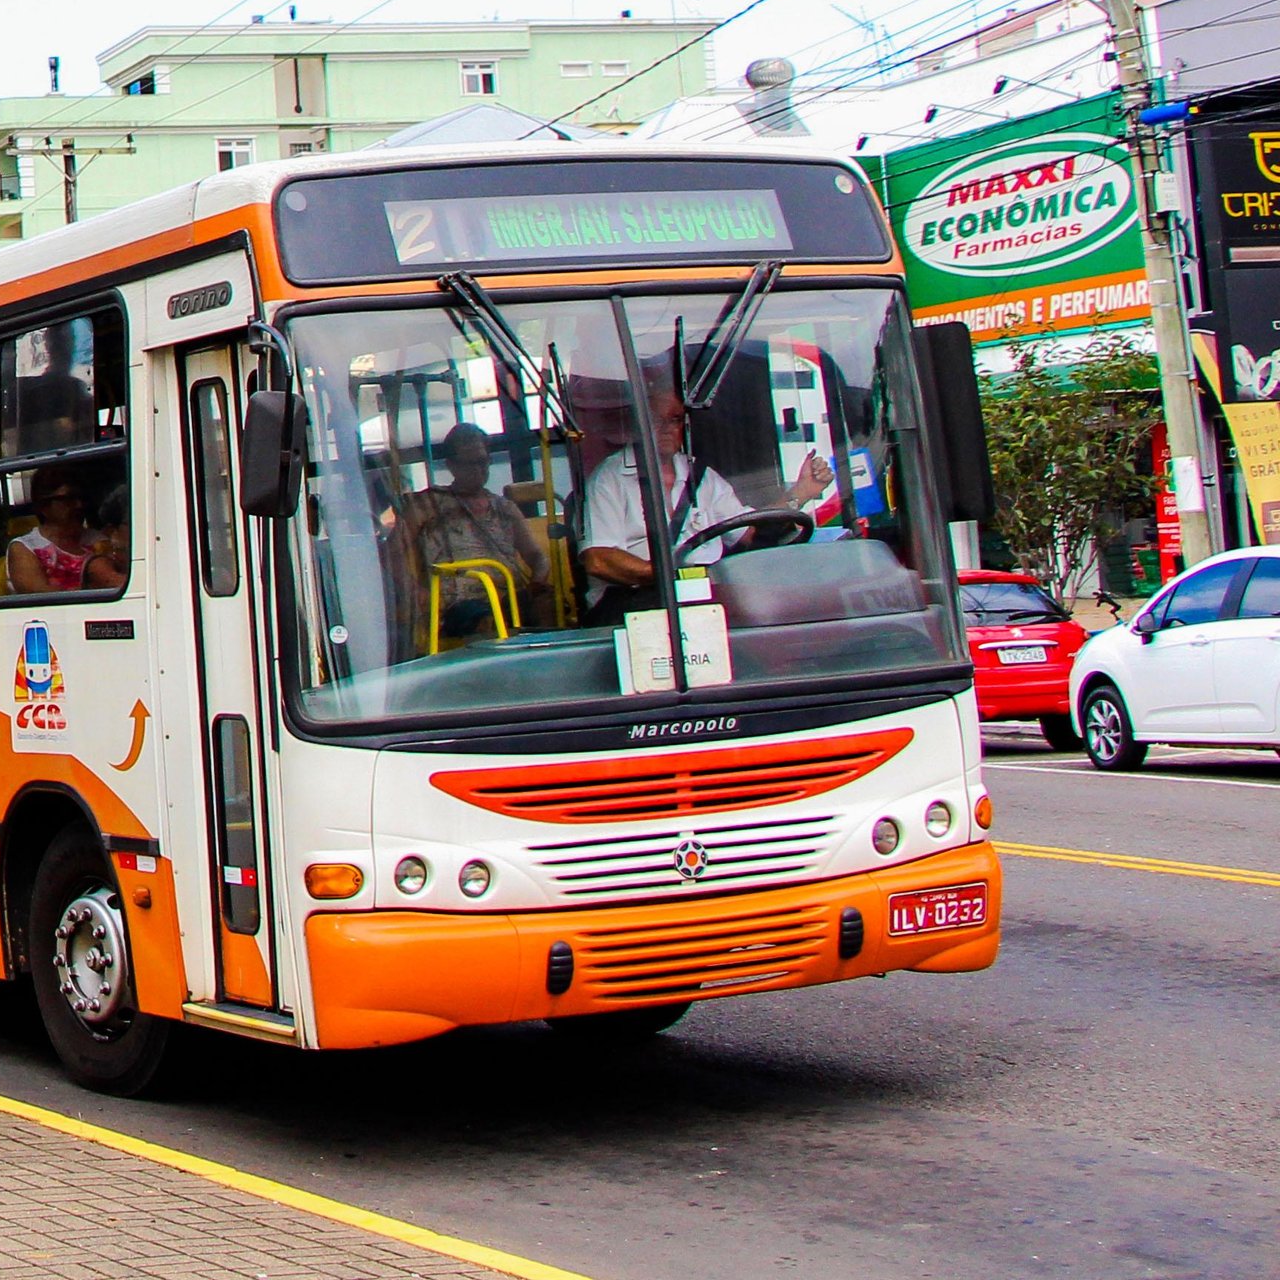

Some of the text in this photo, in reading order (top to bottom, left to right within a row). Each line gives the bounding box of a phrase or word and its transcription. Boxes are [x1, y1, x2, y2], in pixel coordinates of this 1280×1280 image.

[946, 157, 1075, 208] MAXXI
[920, 181, 1118, 246] ECONÔMICA
[1253, 223, 1280, 231] CON
[395, 206, 436, 262] 2
[953, 222, 1083, 260] Farmácias
[171, 287, 228, 317] Torino
[1031, 297, 1043, 322] E
[1049, 279, 1152, 319] PERFUMAR
[630, 716, 737, 739] Marcopolo
[893, 897, 984, 930] ILV-0232
